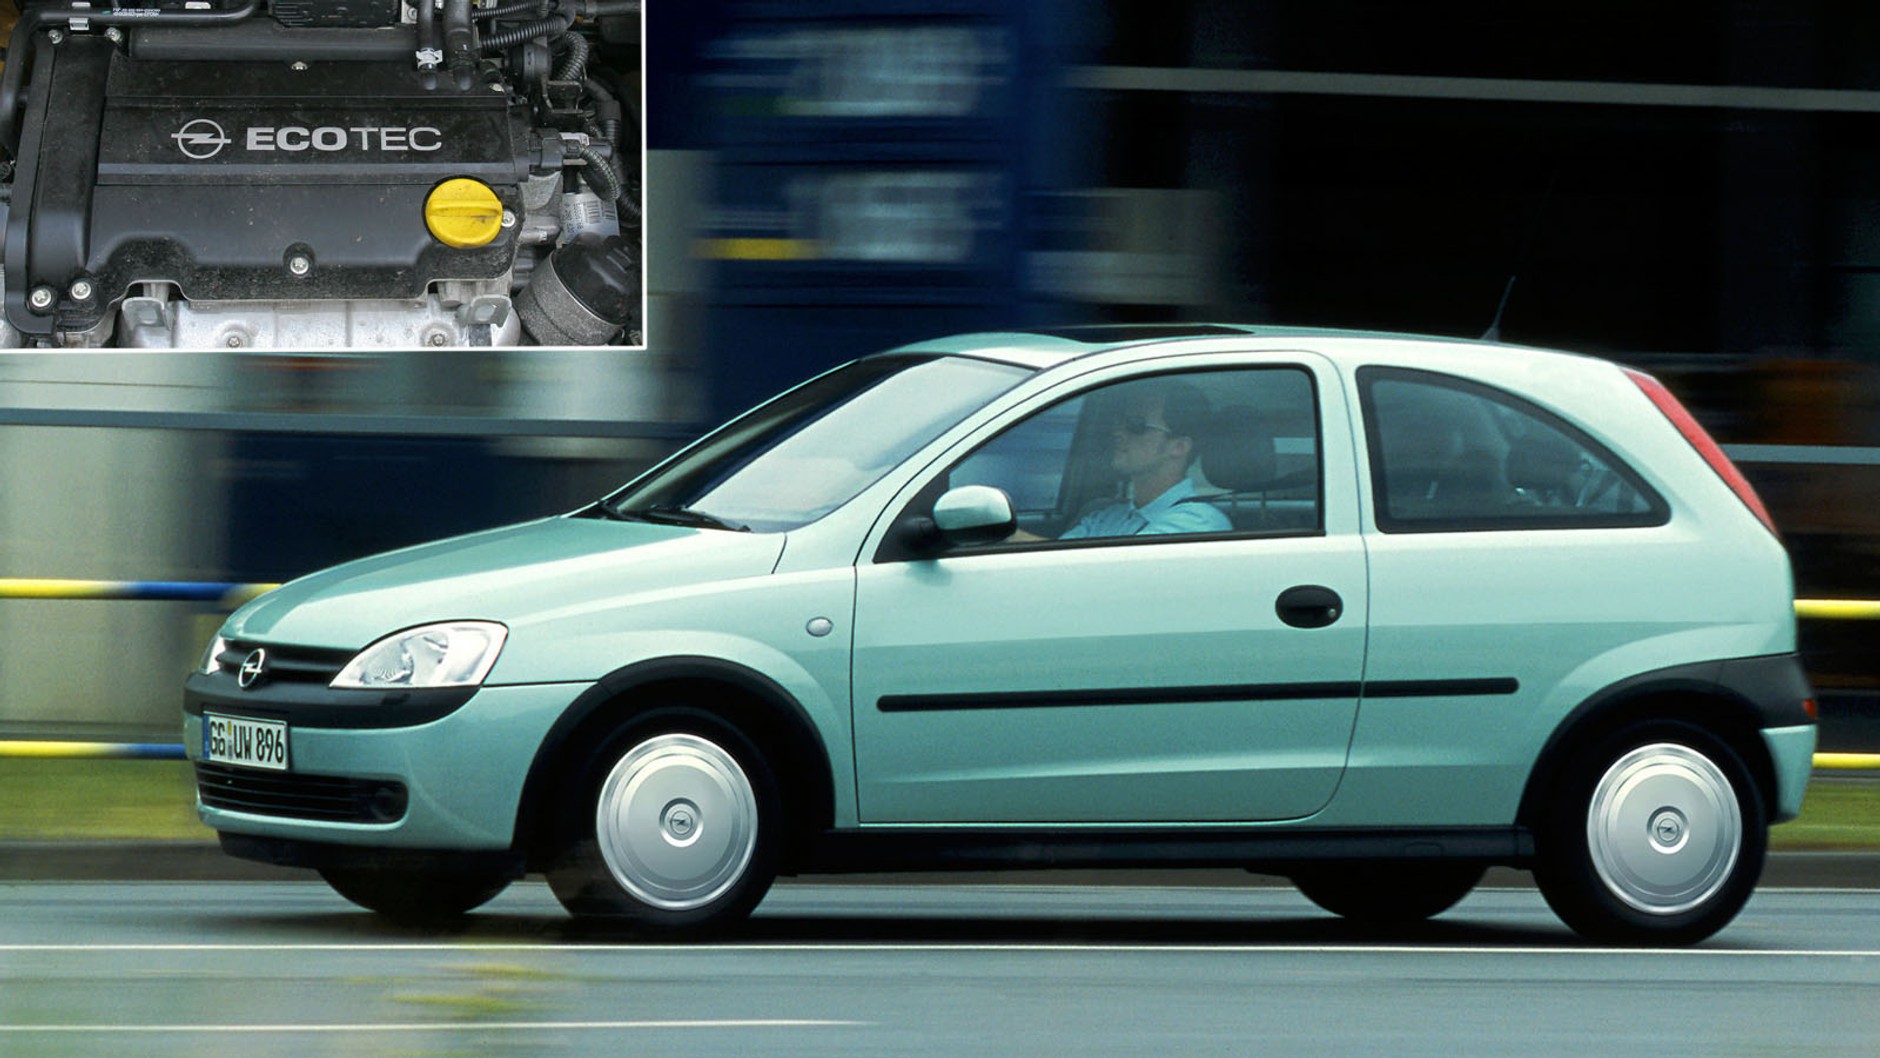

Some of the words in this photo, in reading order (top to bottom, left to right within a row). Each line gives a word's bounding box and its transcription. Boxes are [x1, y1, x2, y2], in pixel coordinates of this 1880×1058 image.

[246, 127, 442, 151] ECOTEC
[233, 724, 251, 760] UW
[256, 727, 284, 763] 896
